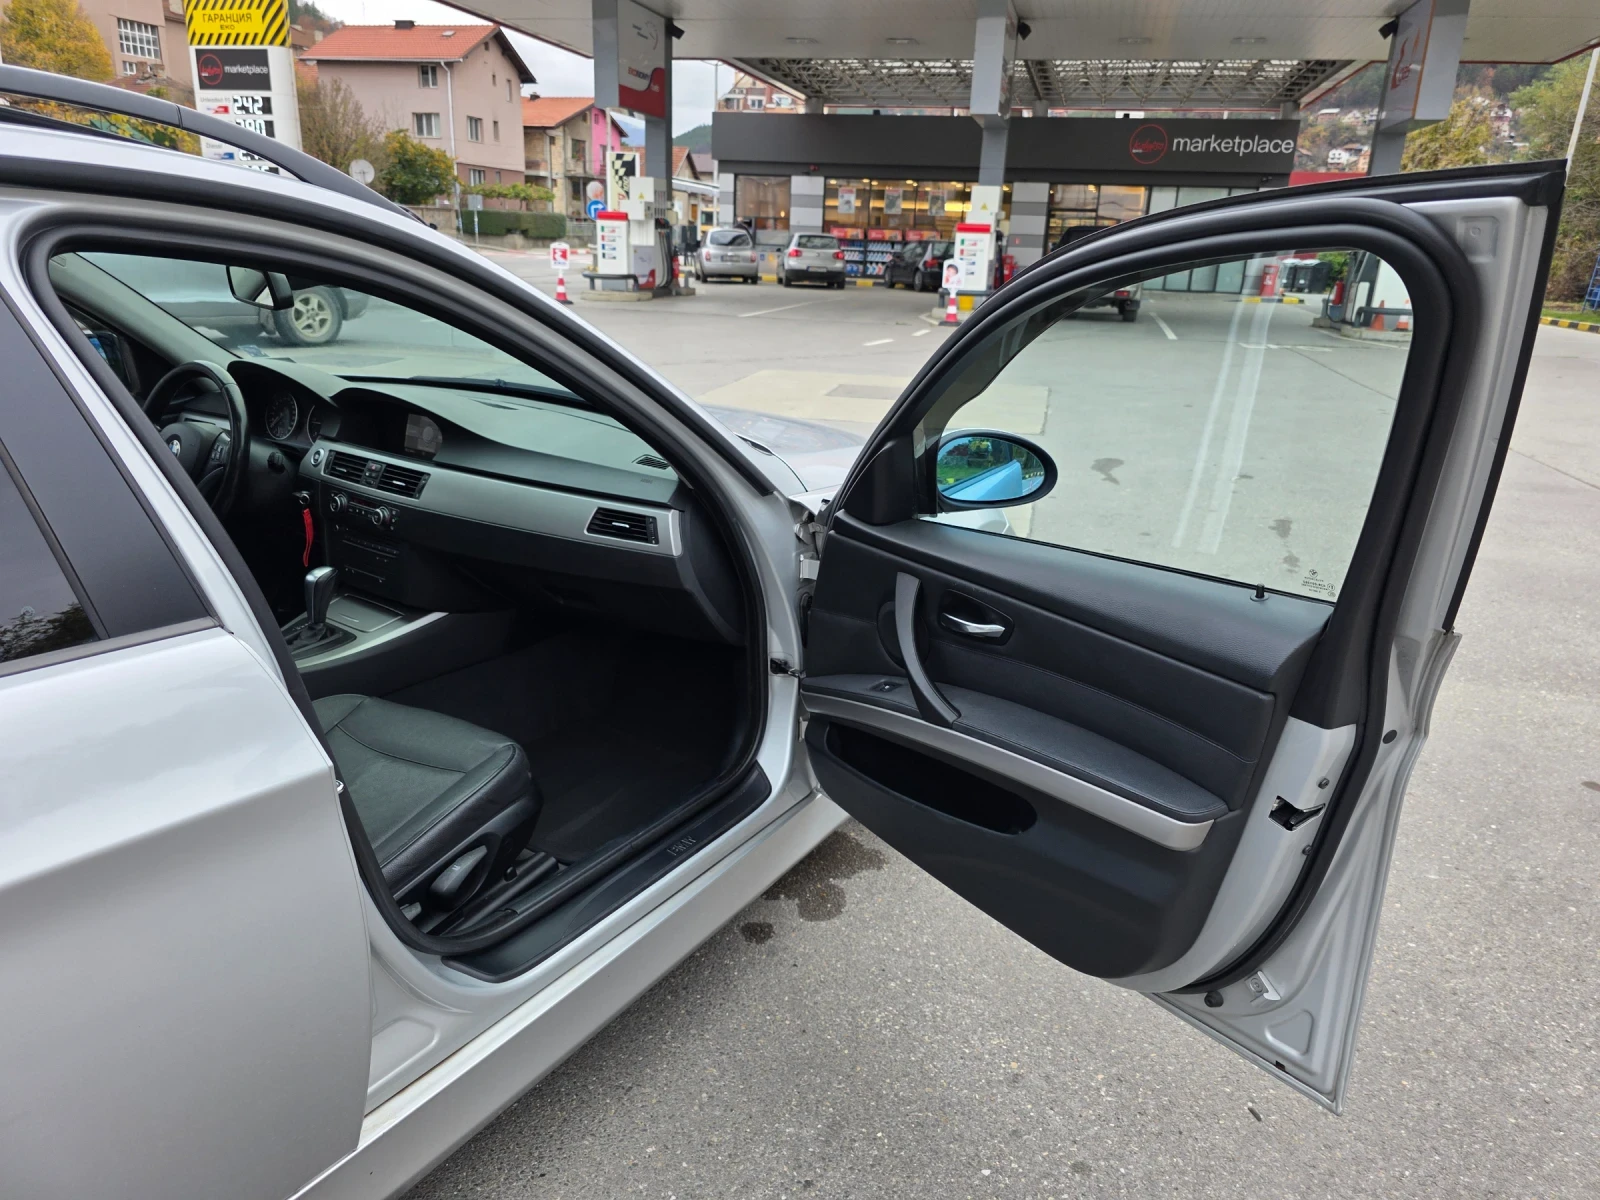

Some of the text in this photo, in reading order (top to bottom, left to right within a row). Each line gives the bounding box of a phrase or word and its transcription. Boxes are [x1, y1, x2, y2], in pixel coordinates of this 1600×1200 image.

[202, 13, 253, 24] ГАРАНЦИЯ
[224, 64, 268, 75] marketplace
[1172, 134, 1295, 157] marketplace
